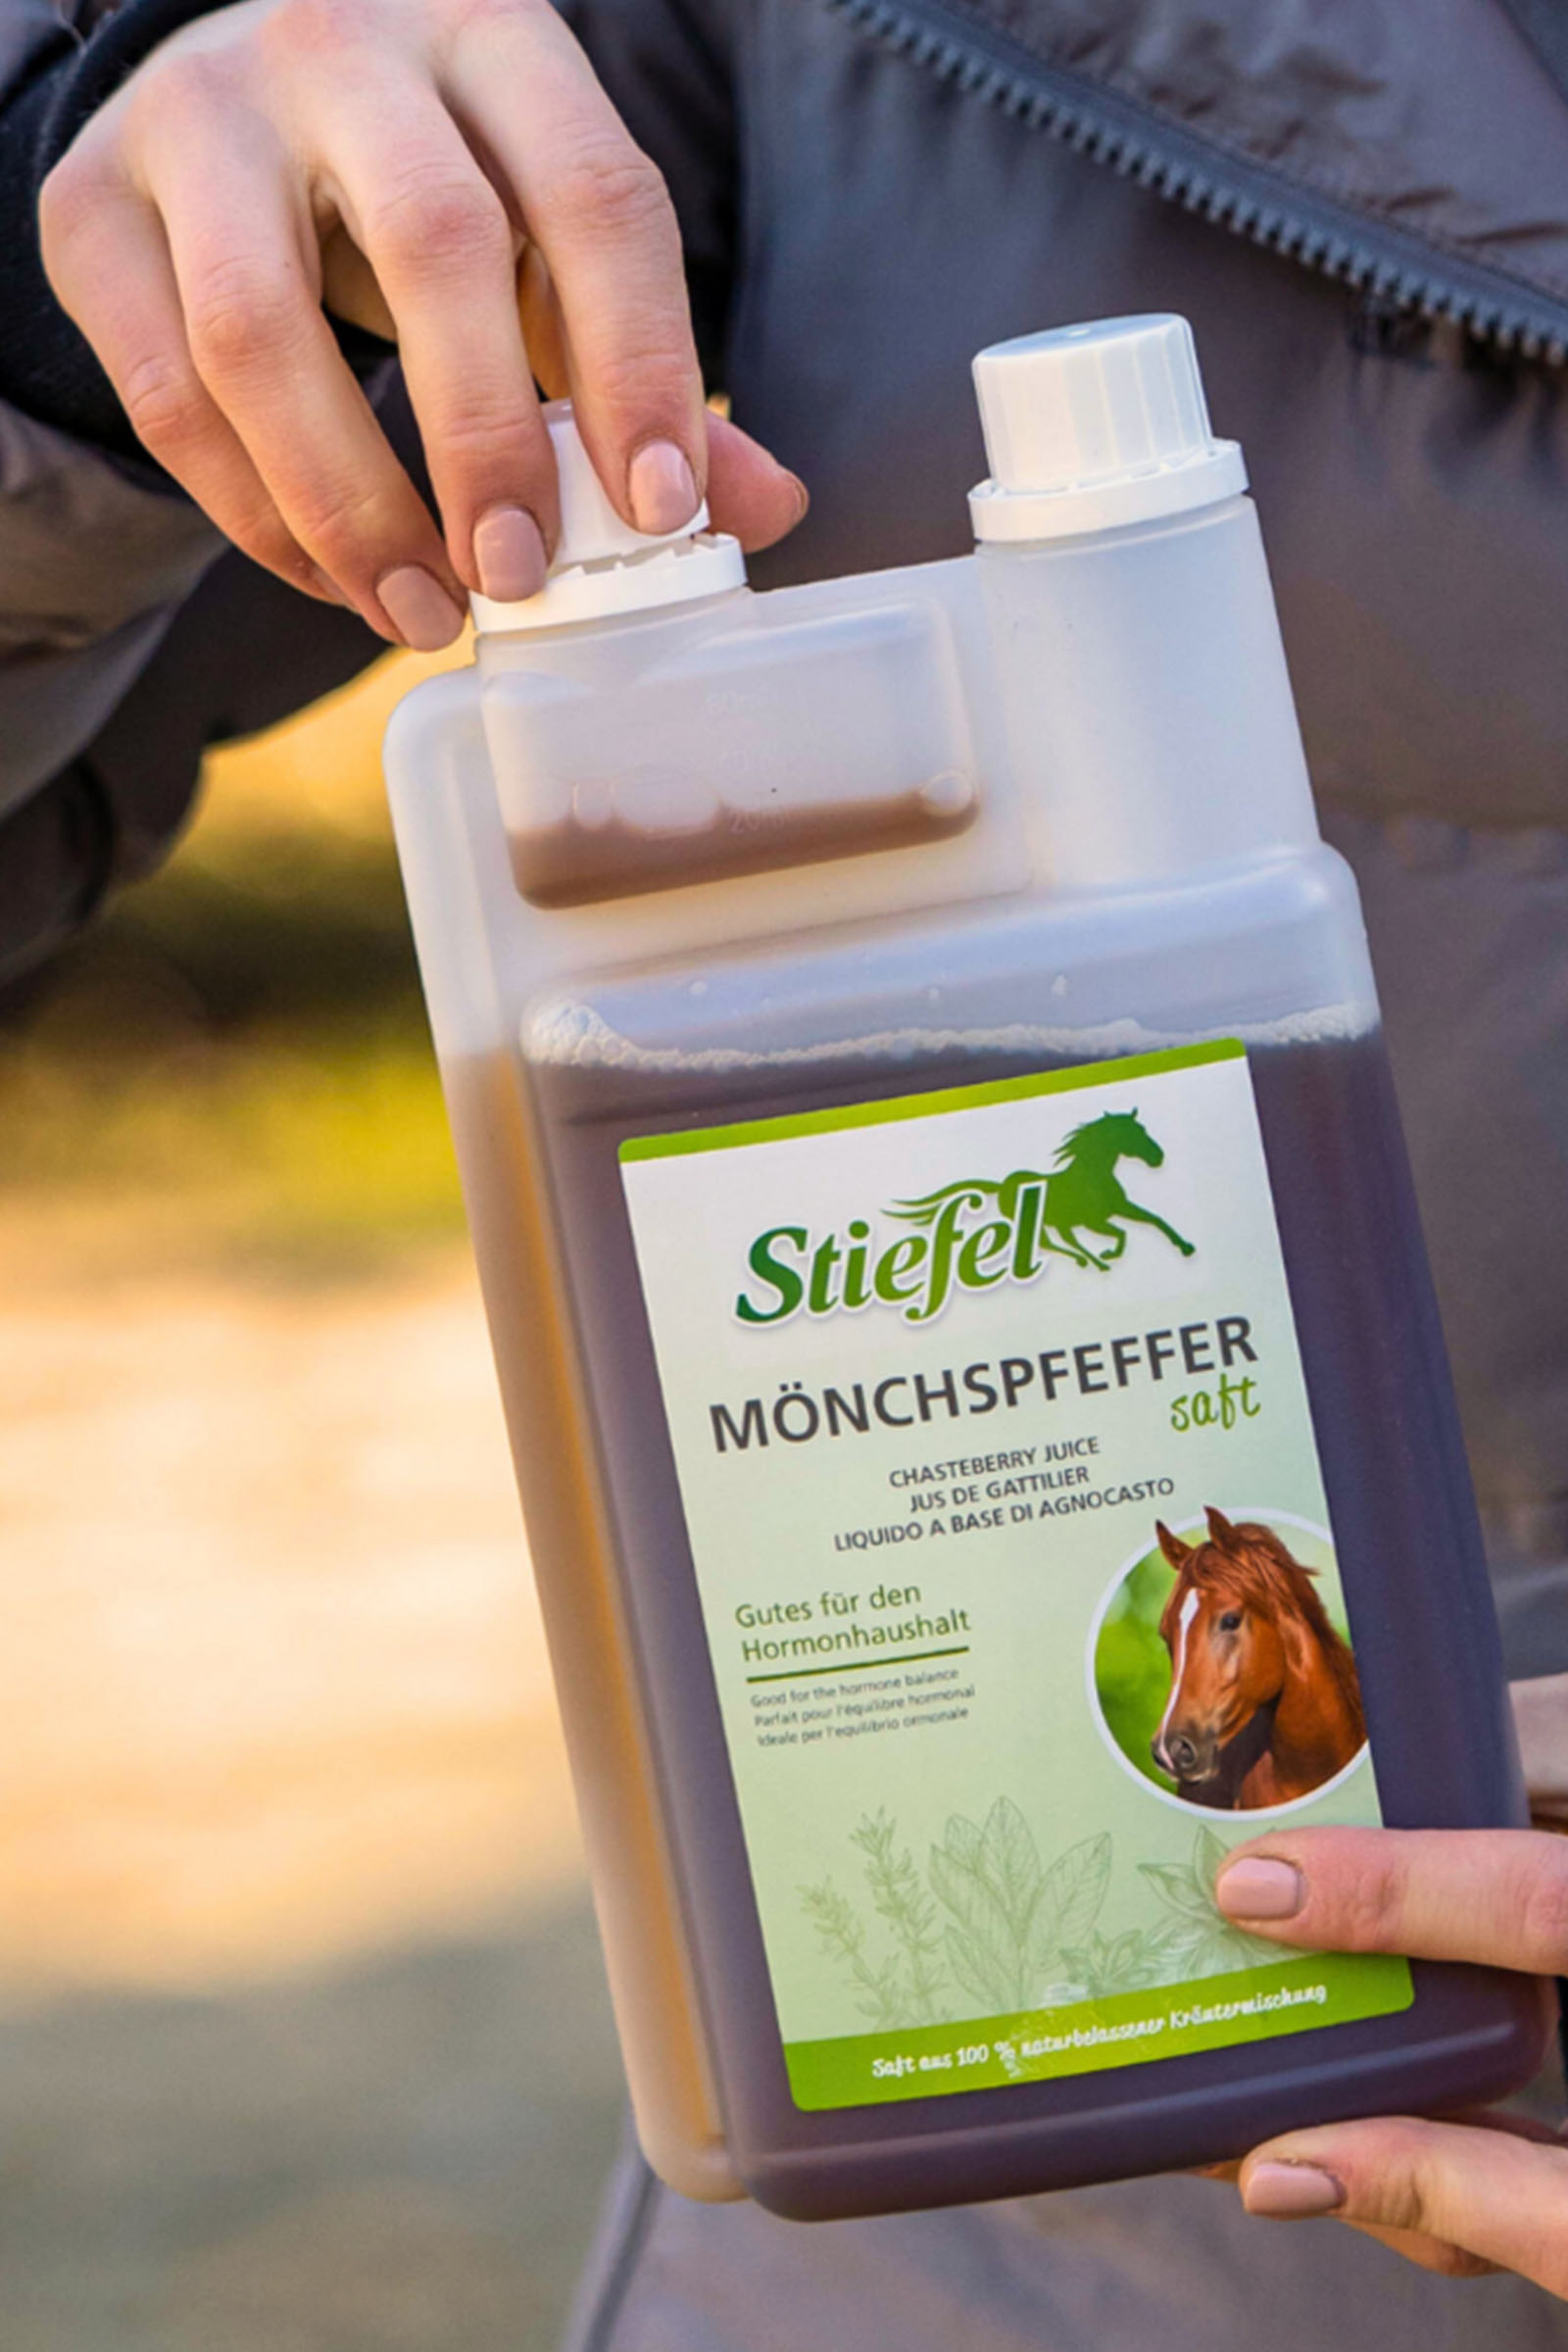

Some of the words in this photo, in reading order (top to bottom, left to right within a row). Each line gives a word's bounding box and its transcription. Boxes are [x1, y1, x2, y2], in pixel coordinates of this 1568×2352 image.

[735, 1183, 1045, 1324] Stiefel
[709, 1315, 1258, 1453] MÖNCHSPFEFFER
[1170, 1373, 1261, 1431] saft
[889, 1447, 1037, 1489] CHASTEBERRY
[1044, 1437, 1101, 1463] JUICE
[909, 1491, 946, 1513] JUS
[953, 1485, 980, 1504] DE
[986, 1466, 1089, 1499] GATTILIER
[834, 1521, 923, 1552] LIQUIDO
[929, 1519, 946, 1537] A
[952, 1508, 1004, 1534] BASE
[1010, 1503, 1034, 1522] DI
[1039, 1477, 1175, 1518] AGNOCASTO
[735, 1600, 812, 1629] Gutes
[820, 1592, 859, 1616] für
[869, 1584, 921, 1610] den
[742, 1608, 971, 1662] Hormonhaushalt
[751, 1691, 787, 1708] Good
[790, 1689, 810, 1703] for
[813, 1683, 836, 1699] the
[839, 1677, 902, 1696] hormone
[905, 1668, 958, 1687] balance
[755, 1711, 799, 1728] Parfait
[802, 1707, 833, 1725] pour
[907, 1684, 976, 1705] hormonal
[801, 1728, 824, 1743] per
[904, 1706, 969, 1727] ormonale
[872, 2057, 915, 2079] Saft
[918, 2052, 953, 2072] aus
[956, 2044, 990, 2067] 100
[1020, 2018, 1166, 2059] naturbelassener
[1169, 1984, 1328, 2029] Kräutermischung
